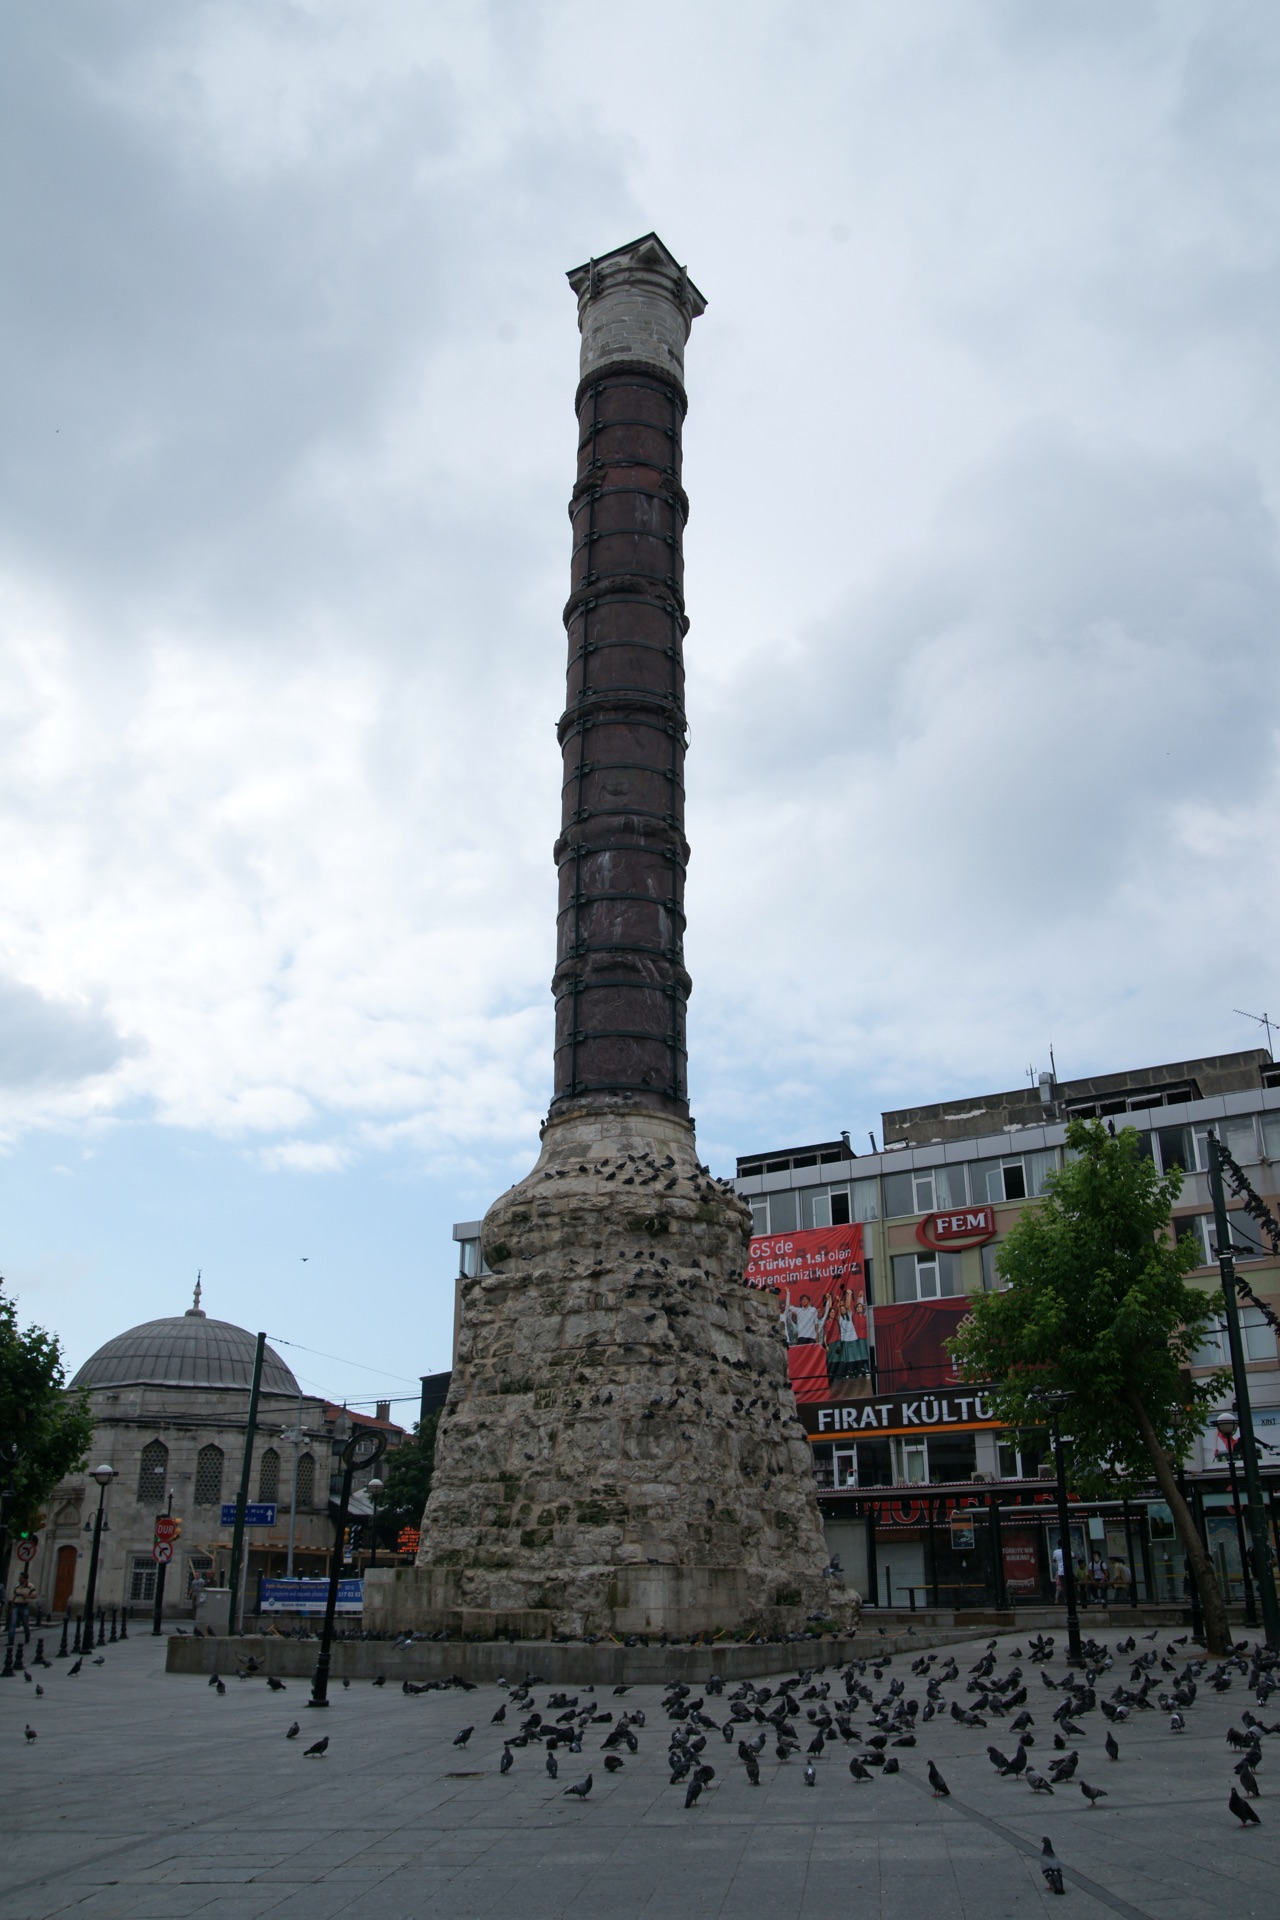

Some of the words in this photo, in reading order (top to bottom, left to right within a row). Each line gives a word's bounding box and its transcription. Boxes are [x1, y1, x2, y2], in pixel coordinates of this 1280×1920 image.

[936, 1213, 987, 1234] FEM
[758, 1256, 803, 1272] Türkiye
[806, 1251, 825, 1265] 1.si
[828, 1248, 852, 1261] olan
[748, 1267, 813, 1286] öğrencimizi
[816, 1262, 857, 1278] kutlarız
[817, 1404, 894, 1432] FIRAT
[901, 1391, 1004, 1425] KÜLTÜ
[157, 1524, 174, 1535] DUR
